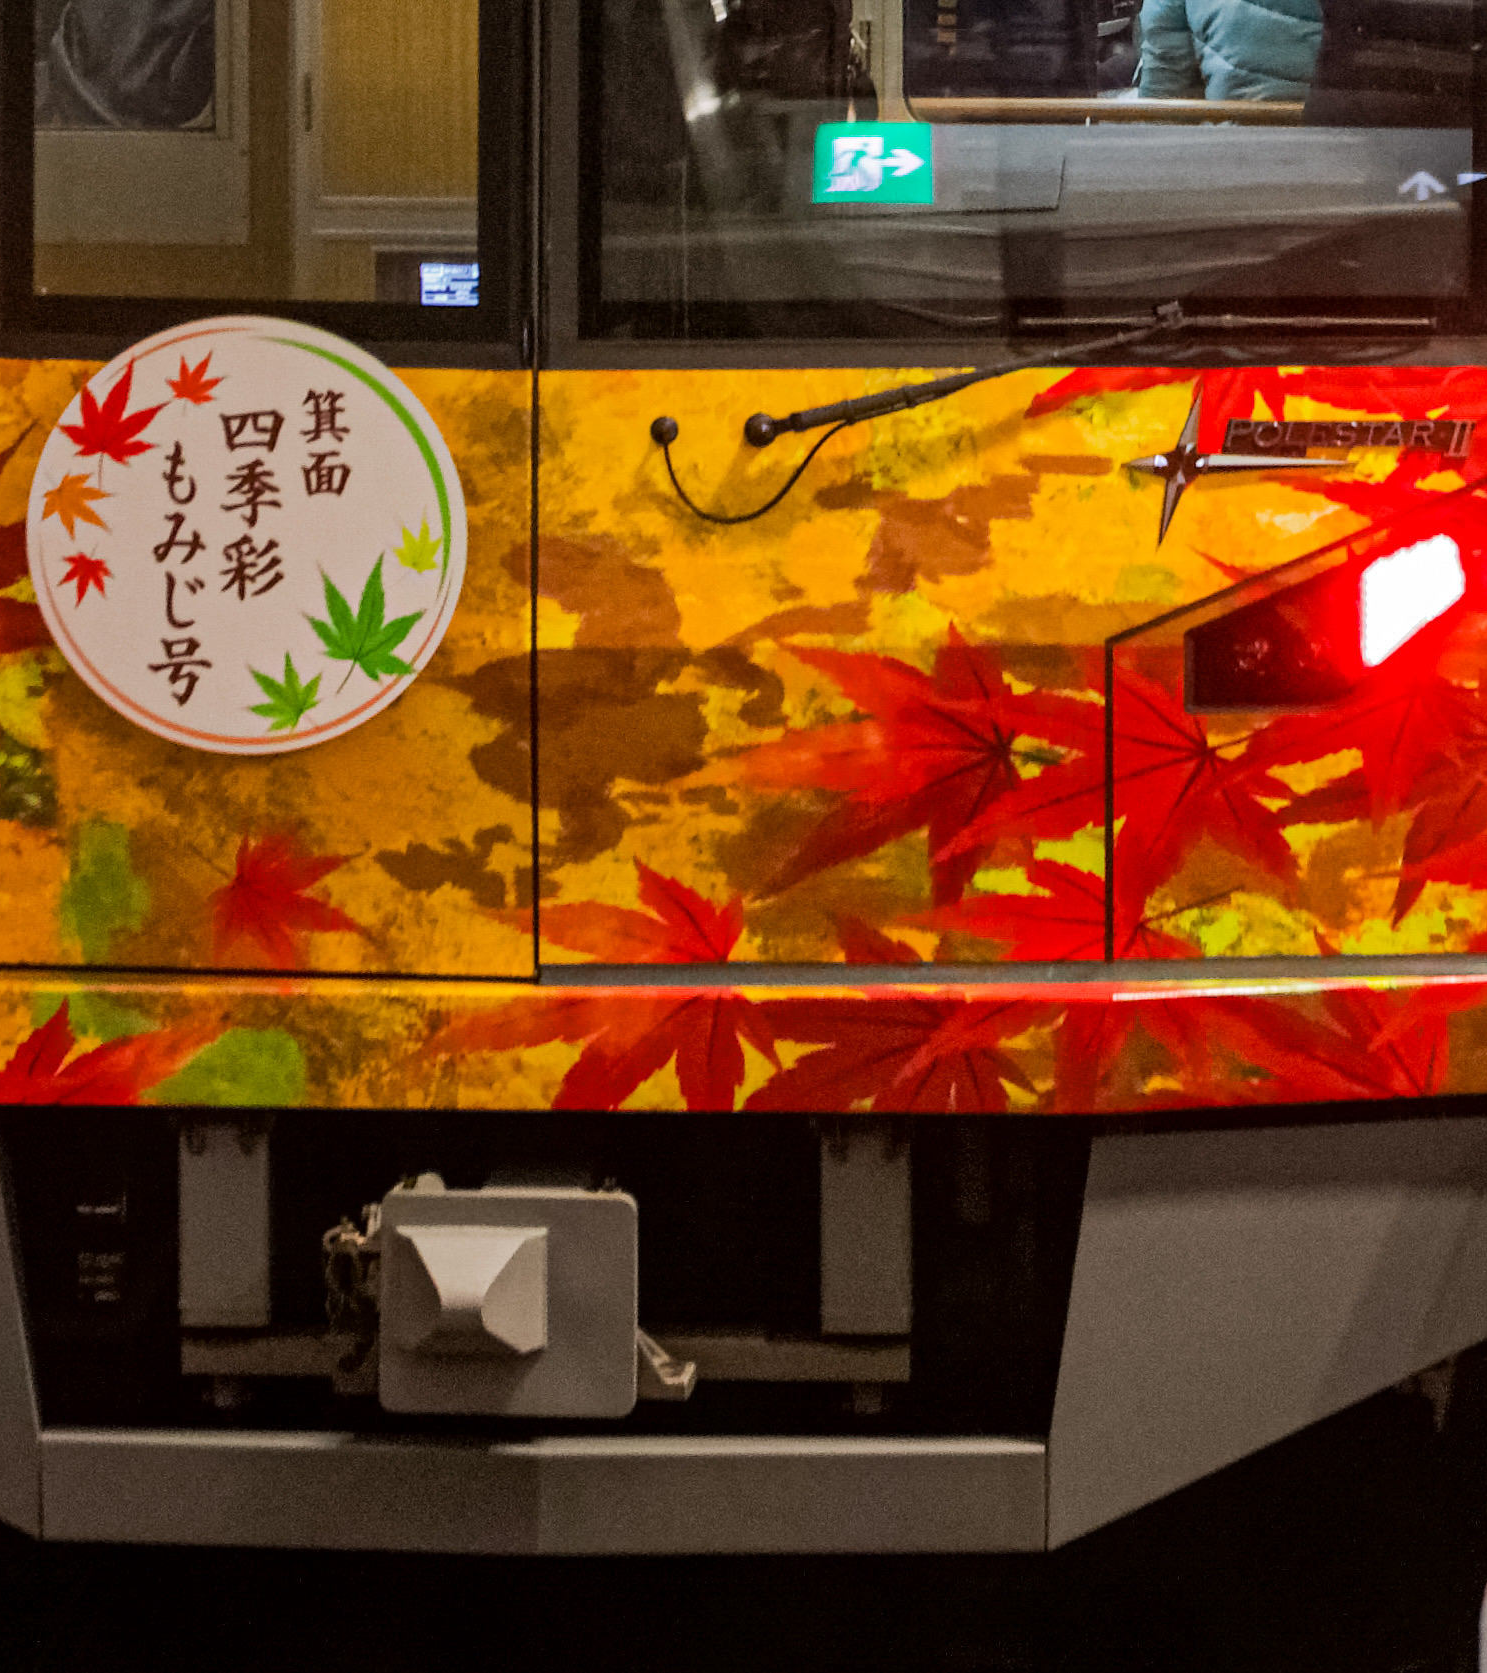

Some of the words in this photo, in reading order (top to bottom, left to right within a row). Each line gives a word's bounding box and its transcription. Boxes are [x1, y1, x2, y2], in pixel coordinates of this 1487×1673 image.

[219, 408, 286, 602] 四季彩
[299, 388, 351, 497] 箕面
[1225, 419, 1435, 449] POLESTAR
[147, 439, 213, 706] もみじ号
